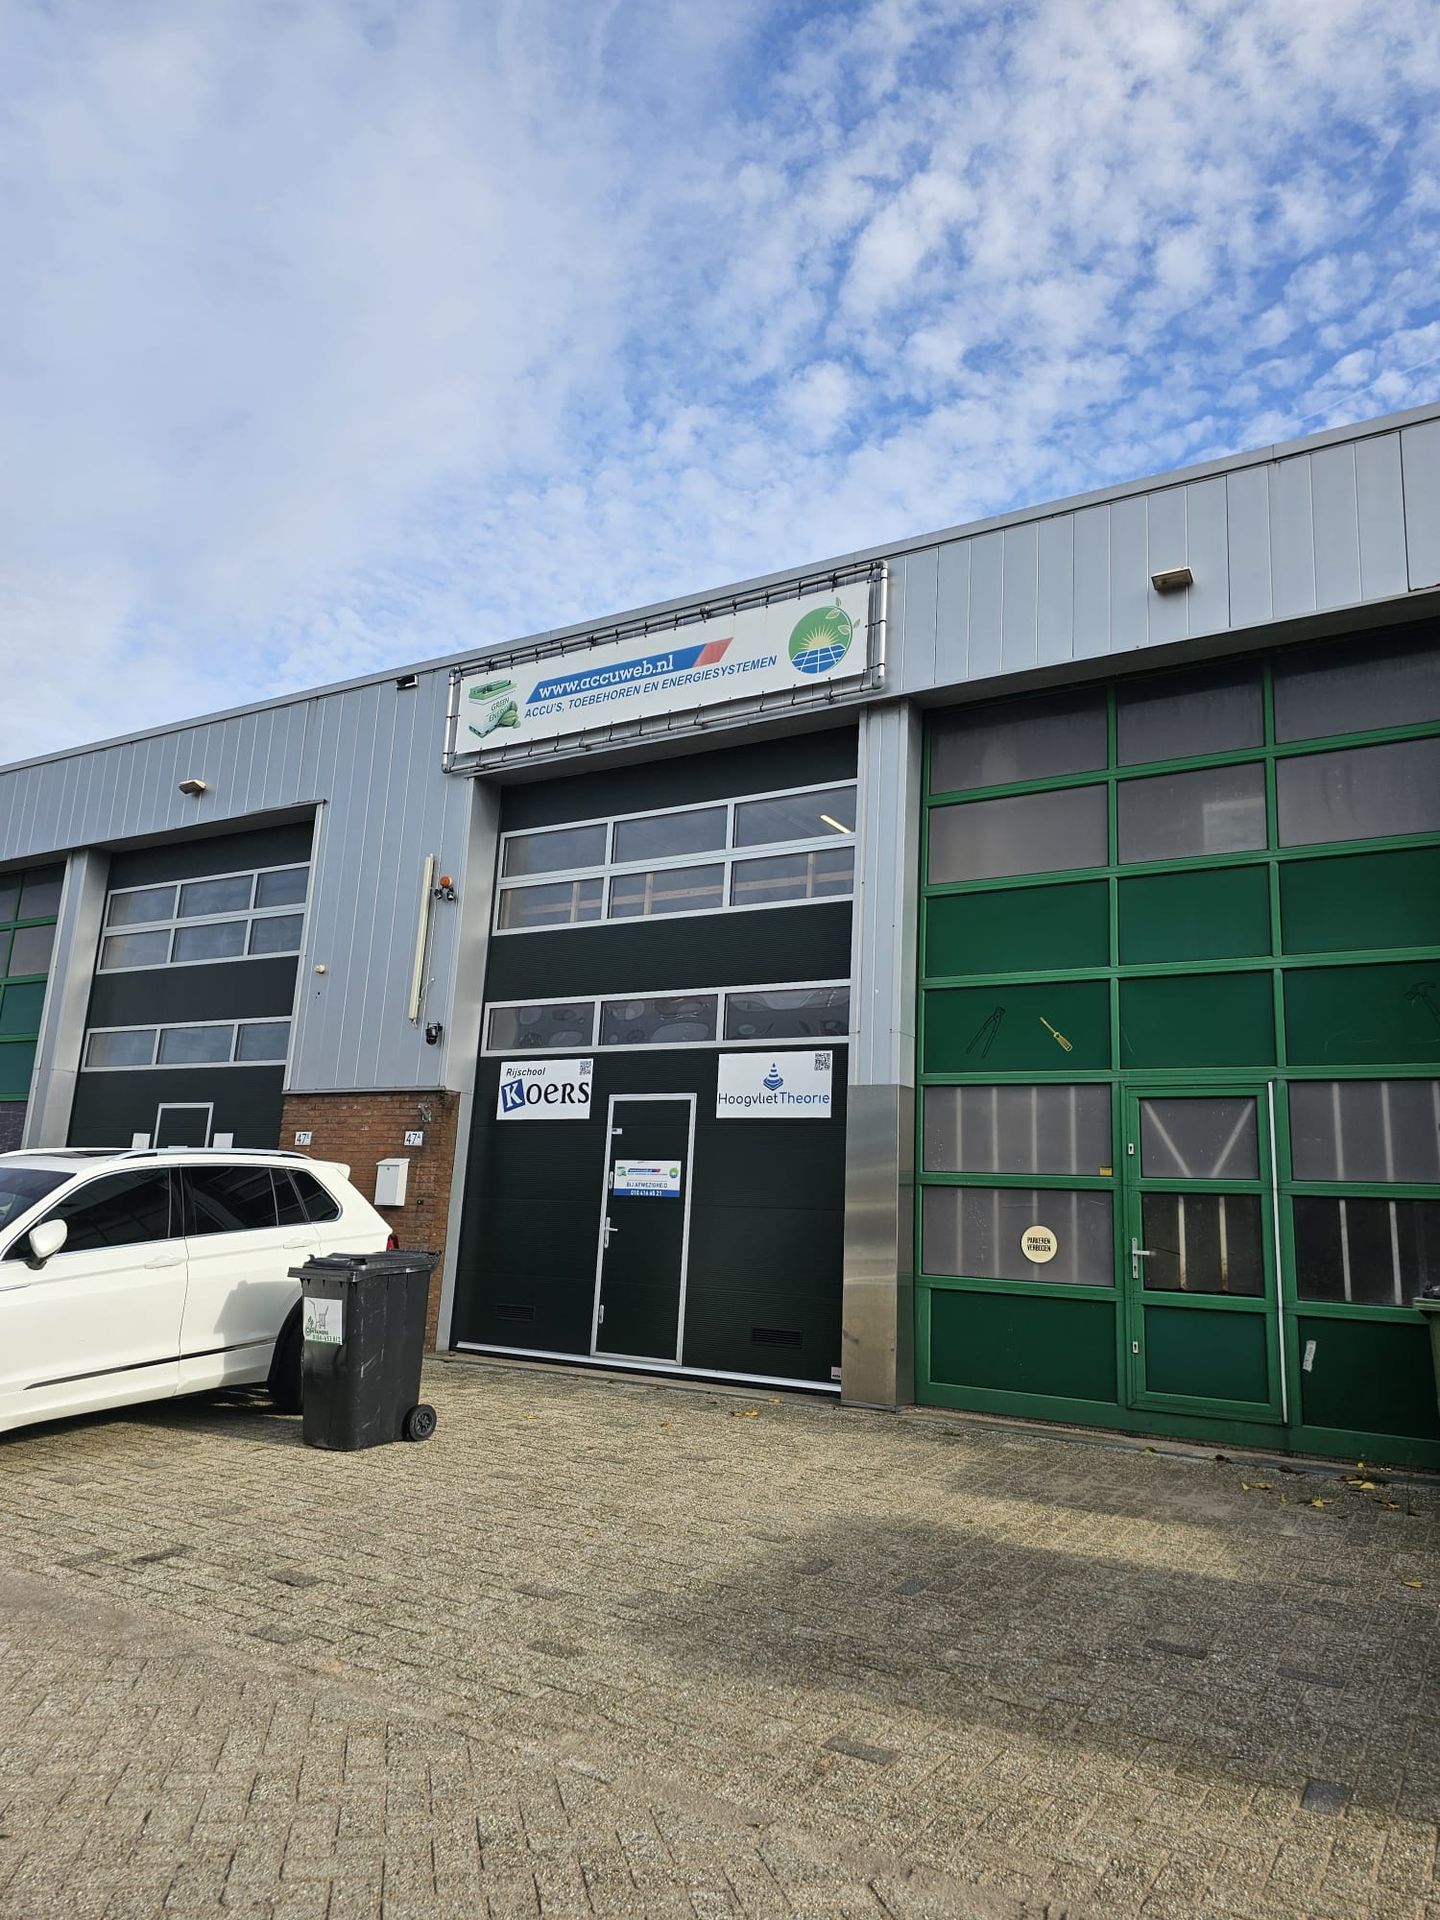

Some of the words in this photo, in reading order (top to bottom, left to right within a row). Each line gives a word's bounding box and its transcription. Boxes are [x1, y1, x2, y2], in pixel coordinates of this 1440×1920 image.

[539, 655, 674, 698] www.accuweb.nl
[524, 702, 565, 719] ACCU'S,
[568, 685, 641, 709] TOEBEHOREN
[643, 681, 659, 693] EN
[661, 655, 777, 689] ENERGIESYSTEMEN
[506, 1067, 546, 1078] Rijschool
[1027, 1236, 1051, 1245] PARKEREN
[1027, 1243, 1051, 1252] VERBODEN
